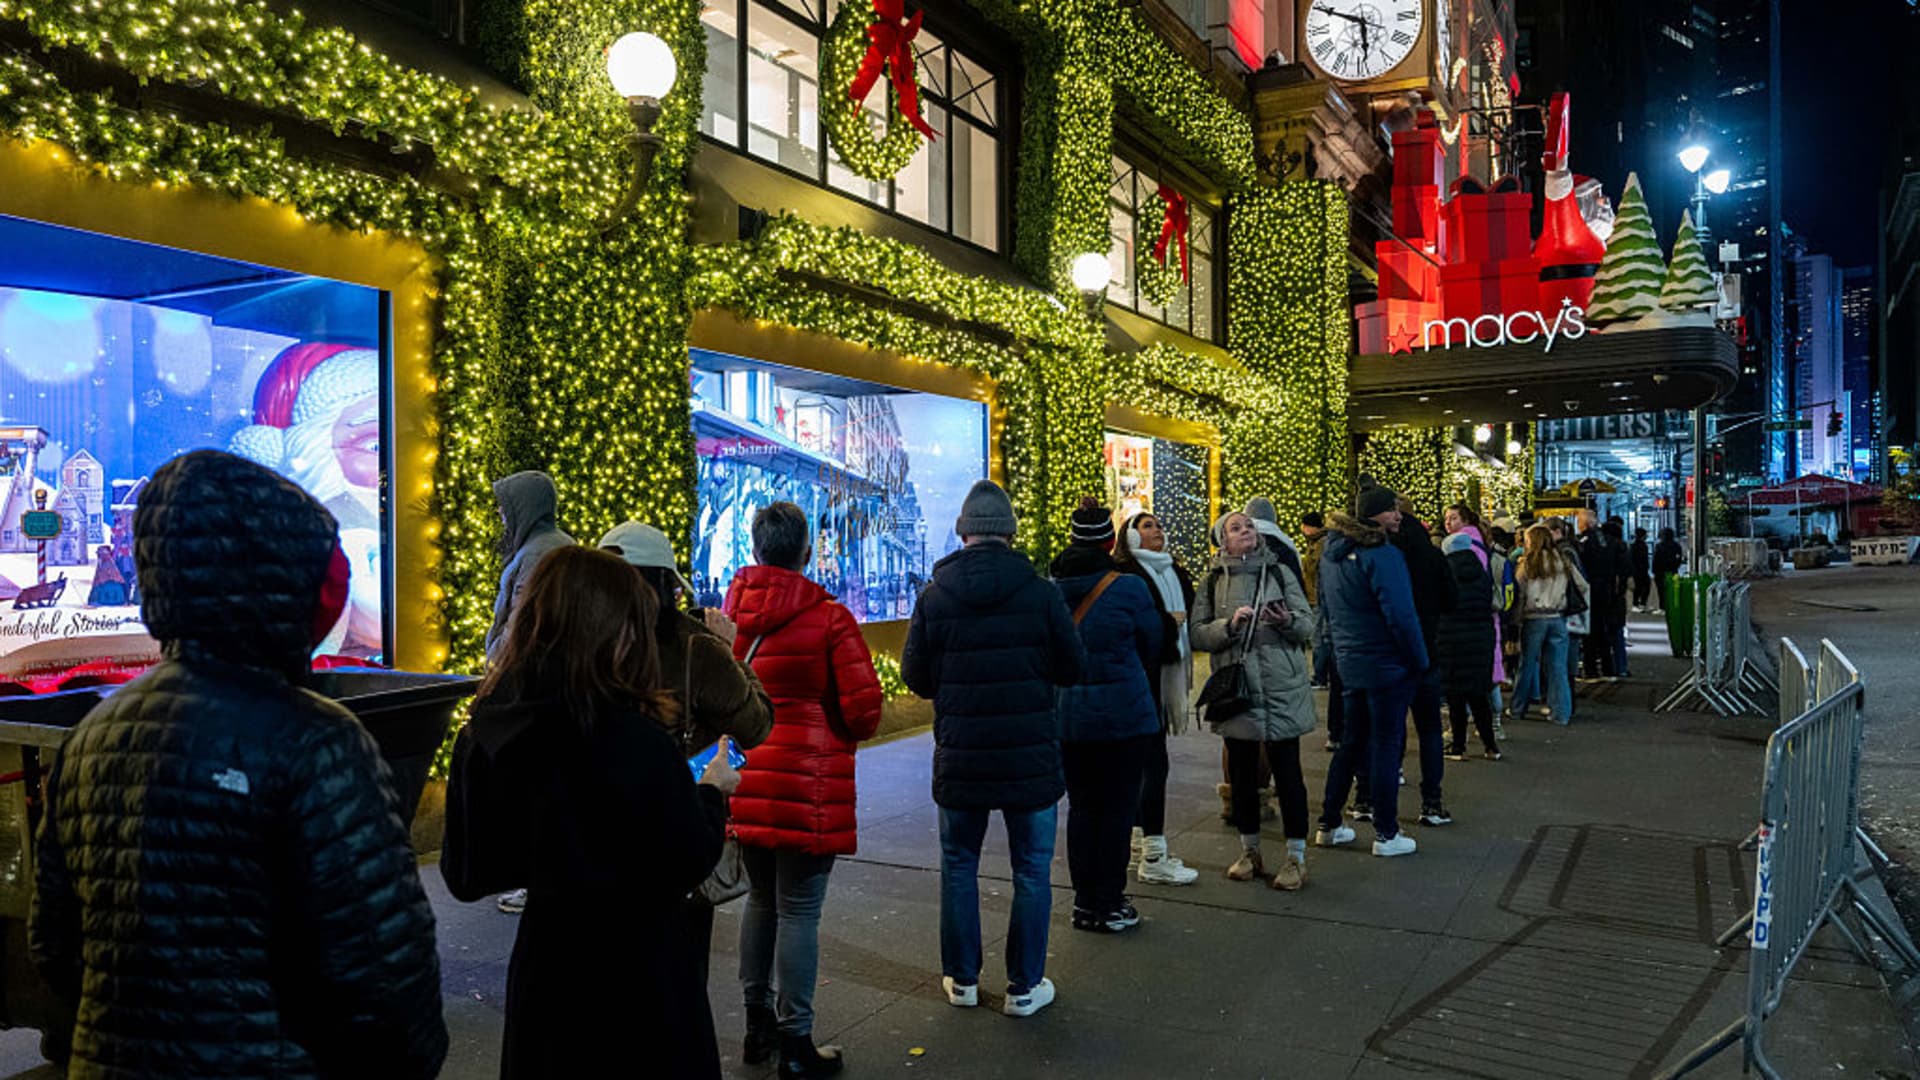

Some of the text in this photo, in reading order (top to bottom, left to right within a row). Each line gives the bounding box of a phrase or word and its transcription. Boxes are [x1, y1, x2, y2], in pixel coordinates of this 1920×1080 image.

[1424, 297, 1586, 353] macy's
[1857, 543, 1899, 556] NYPD
[0, 609, 121, 640] nderful Stories
